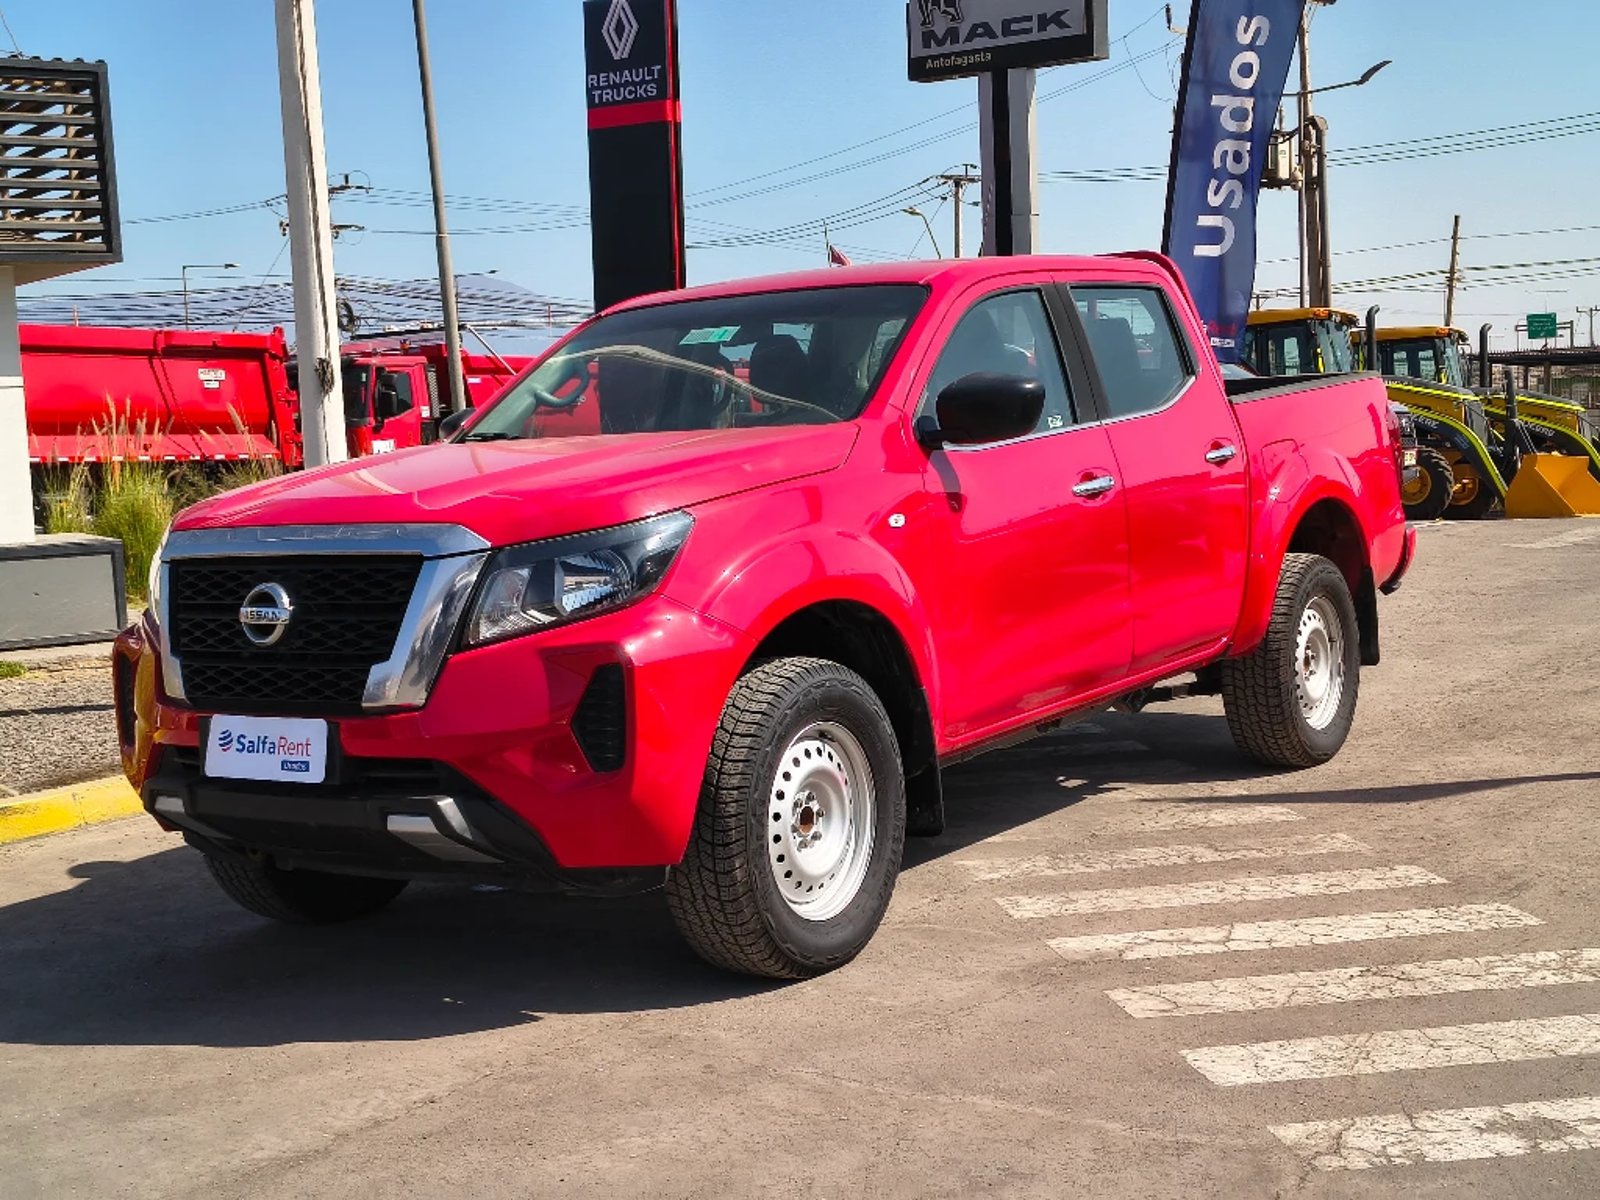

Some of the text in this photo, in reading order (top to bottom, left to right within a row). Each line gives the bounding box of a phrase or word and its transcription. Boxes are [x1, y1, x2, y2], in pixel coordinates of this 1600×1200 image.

[922, 9, 1072, 49] MACK
[926, 52, 992, 69] Antofagasta
[588, 65, 662, 88] RENAULT
[592, 83, 657, 104] TRUCKS
[1193, 15, 1270, 257] Usados
[242, 609, 281, 621] ISSAN
[235, 734, 312, 757] SalfaRent
